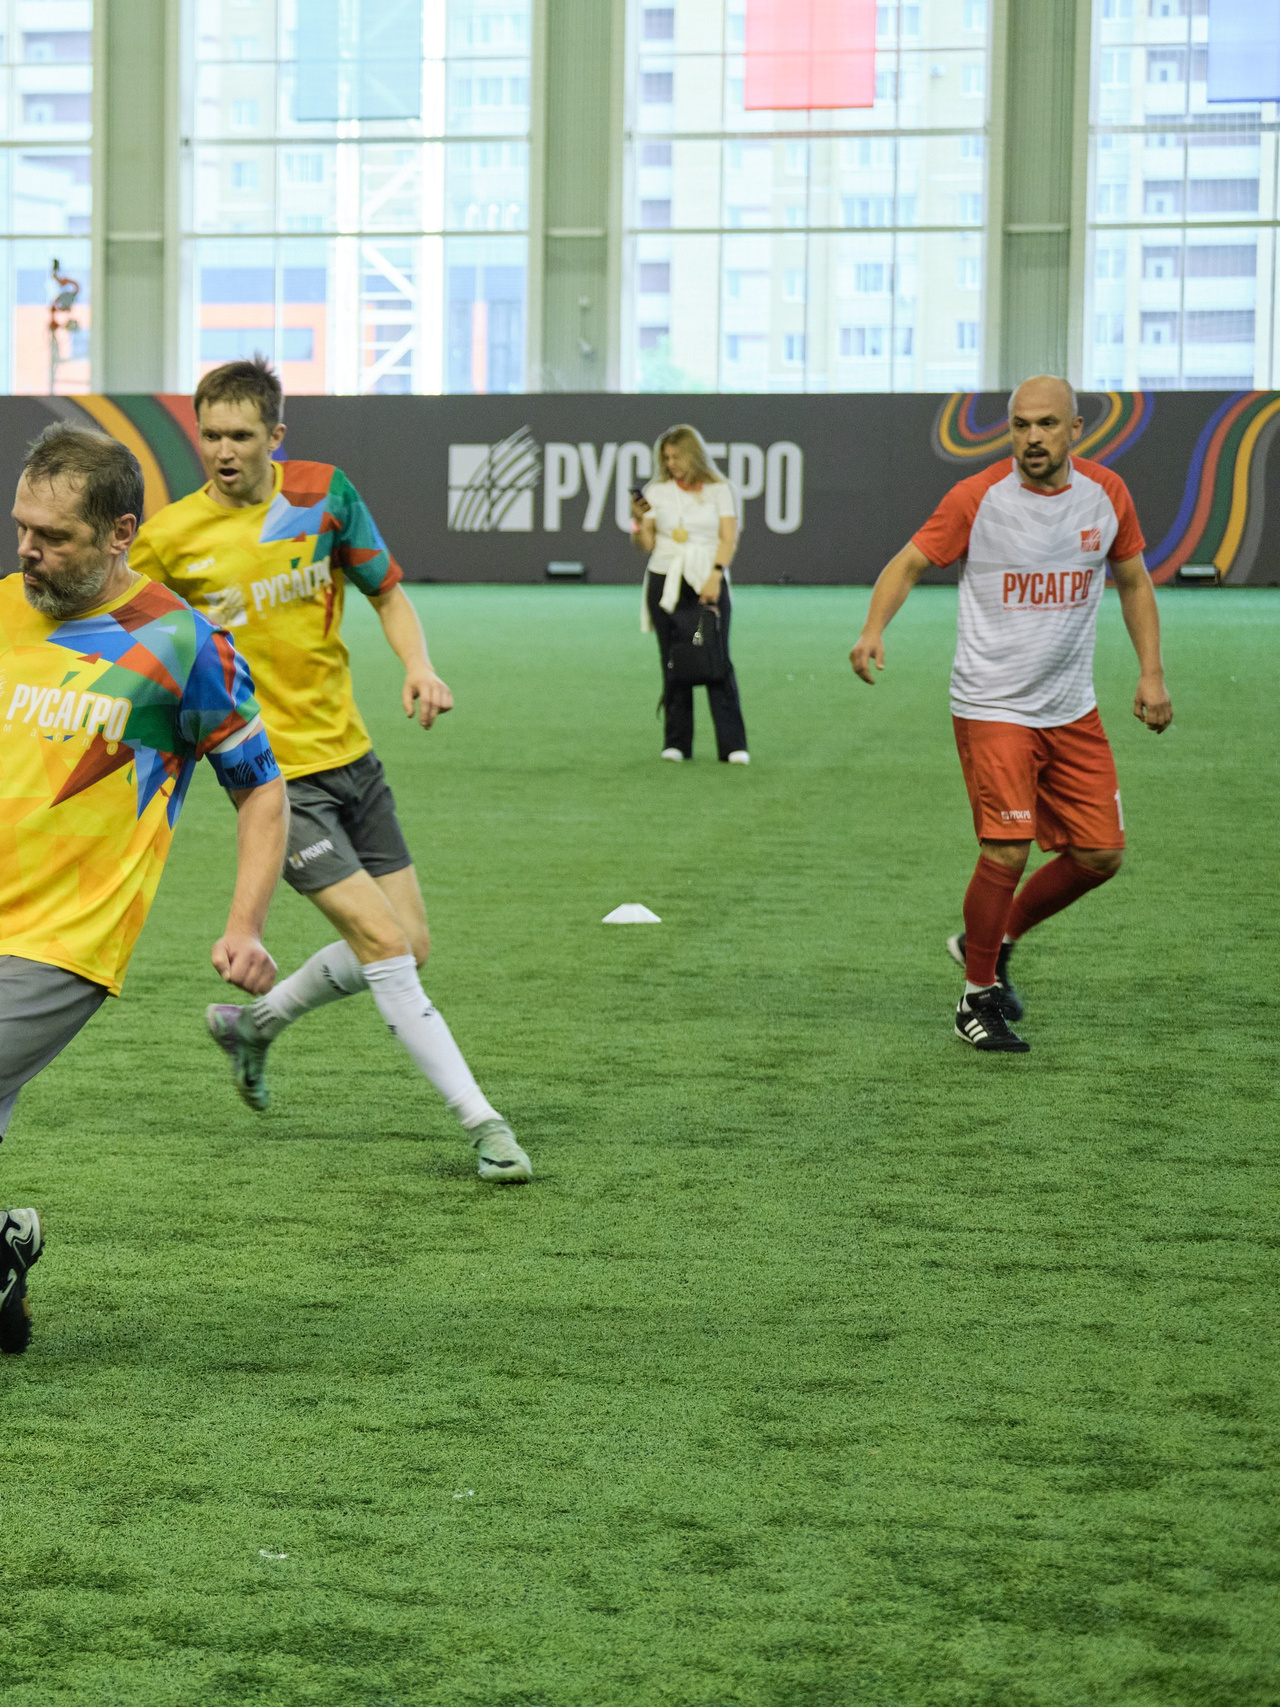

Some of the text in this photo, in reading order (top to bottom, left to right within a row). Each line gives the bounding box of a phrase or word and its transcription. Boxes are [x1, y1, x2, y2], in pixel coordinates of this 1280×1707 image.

[543, 441, 804, 534] РУСРО
[1002, 569, 1094, 605] РУСАГРО
[6, 684, 130, 741] РУСАГРО
